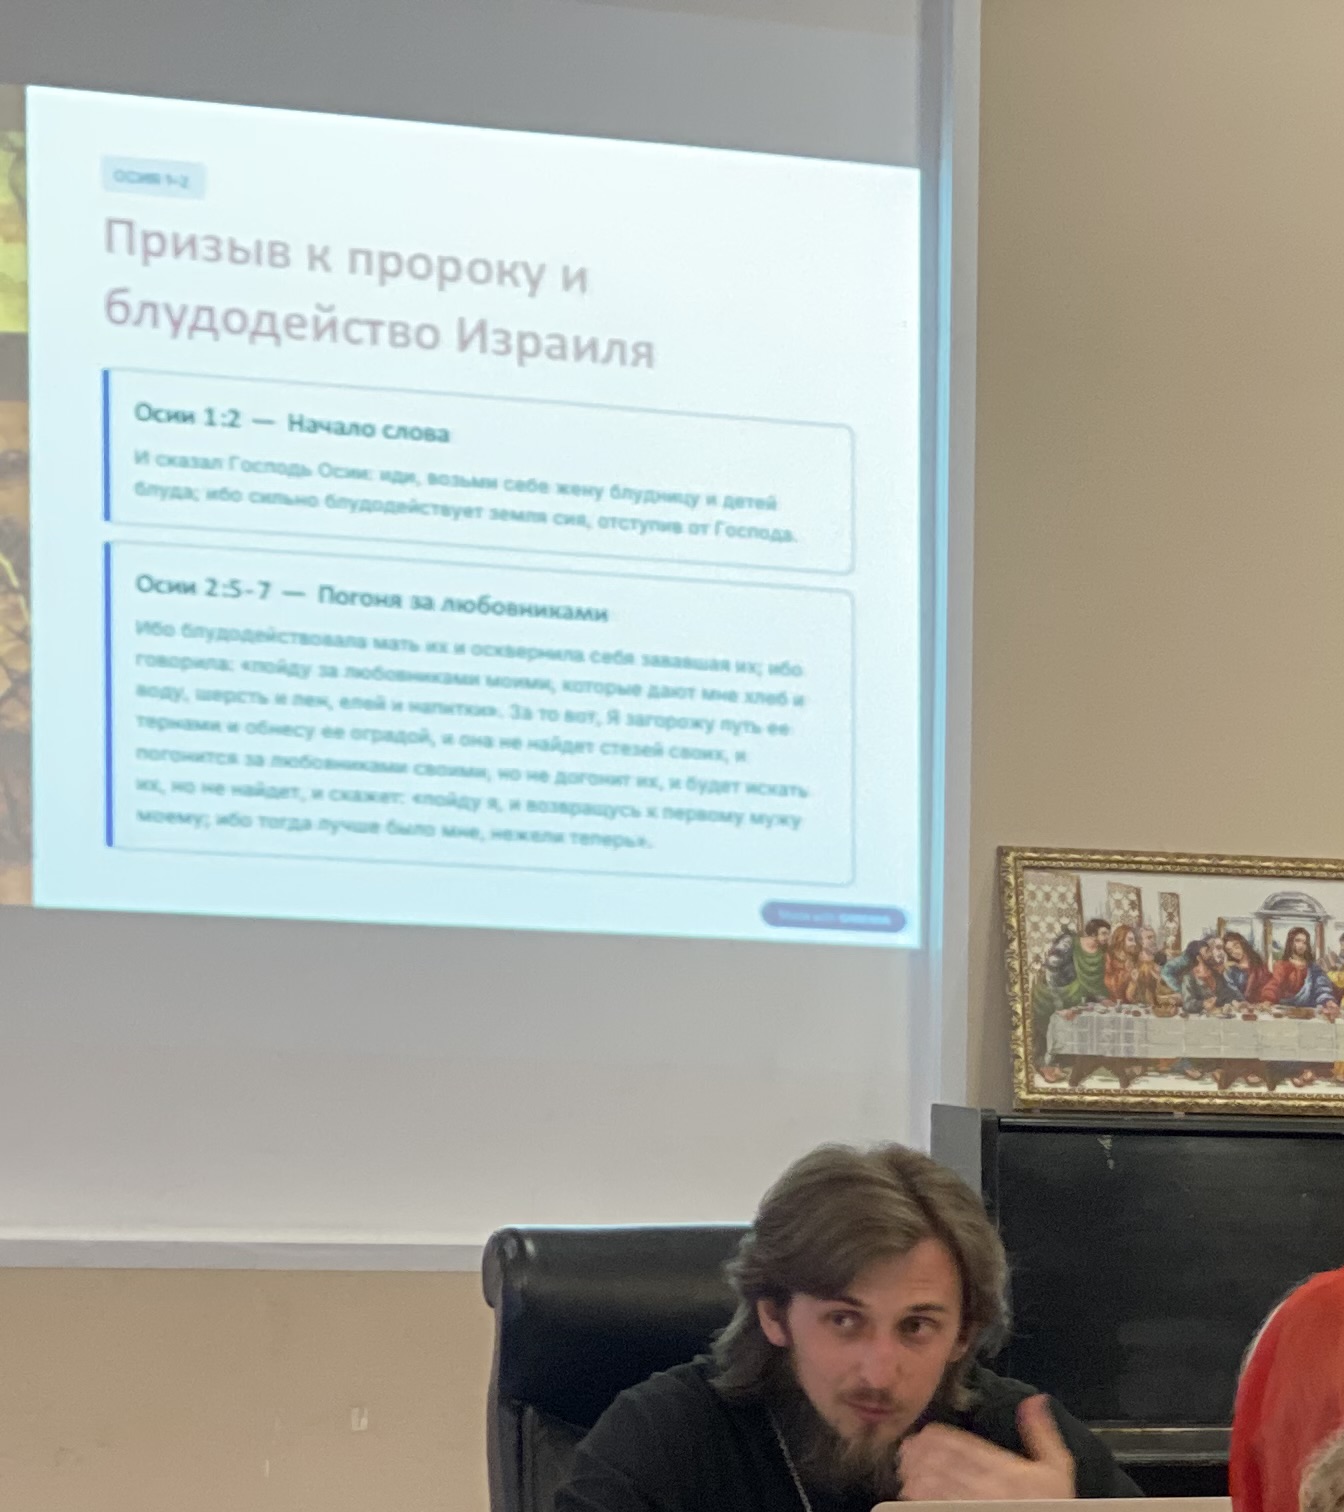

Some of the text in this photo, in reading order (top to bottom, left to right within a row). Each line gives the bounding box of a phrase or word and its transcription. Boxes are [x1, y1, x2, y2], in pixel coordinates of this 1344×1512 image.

[105, 217, 588, 298] Призыв к пророку и
[104, 286, 657, 368] блудодейство Израиля
[134, 402, 196, 424] Осии
[204, 407, 240, 427] 1:2
[288, 413, 376, 437] Начало
[381, 424, 450, 442] слова
[134, 450, 150, 463] И
[154, 454, 223, 469] сказал
[227, 455, 312, 477] Господь
[427, 472, 498, 489] возьми
[503, 478, 550, 493] себе
[556, 483, 604, 501] жену
[609, 484, 700, 509] блудницу
[705, 495, 718, 505] и
[722, 495, 777, 510] детей
[205, 487, 243, 502] ибо
[247, 491, 319, 507] сильно
[323, 493, 483, 520] блудодействует
[597, 516, 683, 534] отступив
[687, 522, 710, 534] от
[135, 574, 197, 594] Осии
[318, 584, 402, 608] Погоня
[410, 595, 434, 610] за
[439, 594, 608, 622] любовниками
[135, 620, 175, 636] Ибо
[180, 623, 368, 649] блудодействовала
[371, 638, 420, 652] мать
[424, 641, 447, 653] их
[453, 643, 465, 654] и
[589, 650, 635, 664] себя
[767, 660, 803, 677] ибо
[319, 665, 338, 678] за
[344, 665, 480, 685] любовниками
[561, 680, 642, 696] которые
[646, 684, 695, 699] дают
[700, 688, 738, 702] мне
[744, 690, 788, 706] хлеб
[792, 695, 804, 707] и
[195, 689, 268, 704] шерсть
[274, 693, 287, 704] и
[338, 695, 386, 710] елей
[391, 700, 403, 711] и
[511, 703, 532, 720] За
[538, 708, 559, 721] то
[607, 708, 620, 724] Я
[626, 713, 714, 734] загорожу
[719, 719, 761, 735] путь
[766, 723, 789, 735] ее
[137, 715, 221, 731] тернами
[226, 722, 239, 732] и
[245, 720, 314, 740] обнесу
[320, 726, 345, 739] ее
[441, 733, 453, 745] и
[459, 734, 494, 748] она
[498, 737, 522, 749] не
[526, 736, 593, 754] найдет
[599, 742, 664, 757] стезей
[734, 751, 746, 762] и
[135, 747, 238, 764] погонится
[245, 754, 265, 766] за
[270, 754, 409, 773] любовниками
[497, 768, 522, 780] но
[525, 770, 549, 782] не
[554, 771, 631, 786] догонит
[668, 777, 681, 789] и
[684, 776, 740, 794] будет
[745, 782, 809, 798] искать
[171, 781, 195, 793] но
[201, 783, 225, 795] не
[311, 789, 323, 799] и
[509, 799, 521, 810] и
[646, 807, 656, 817] к
[662, 807, 743, 826] первому
[749, 812, 801, 830] мужу
[215, 812, 251, 827] ибо
[258, 816, 312, 831] тогда
[318, 818, 380, 834] лучше
[385, 819, 435, 836] было
[490, 828, 564, 843] нежели
